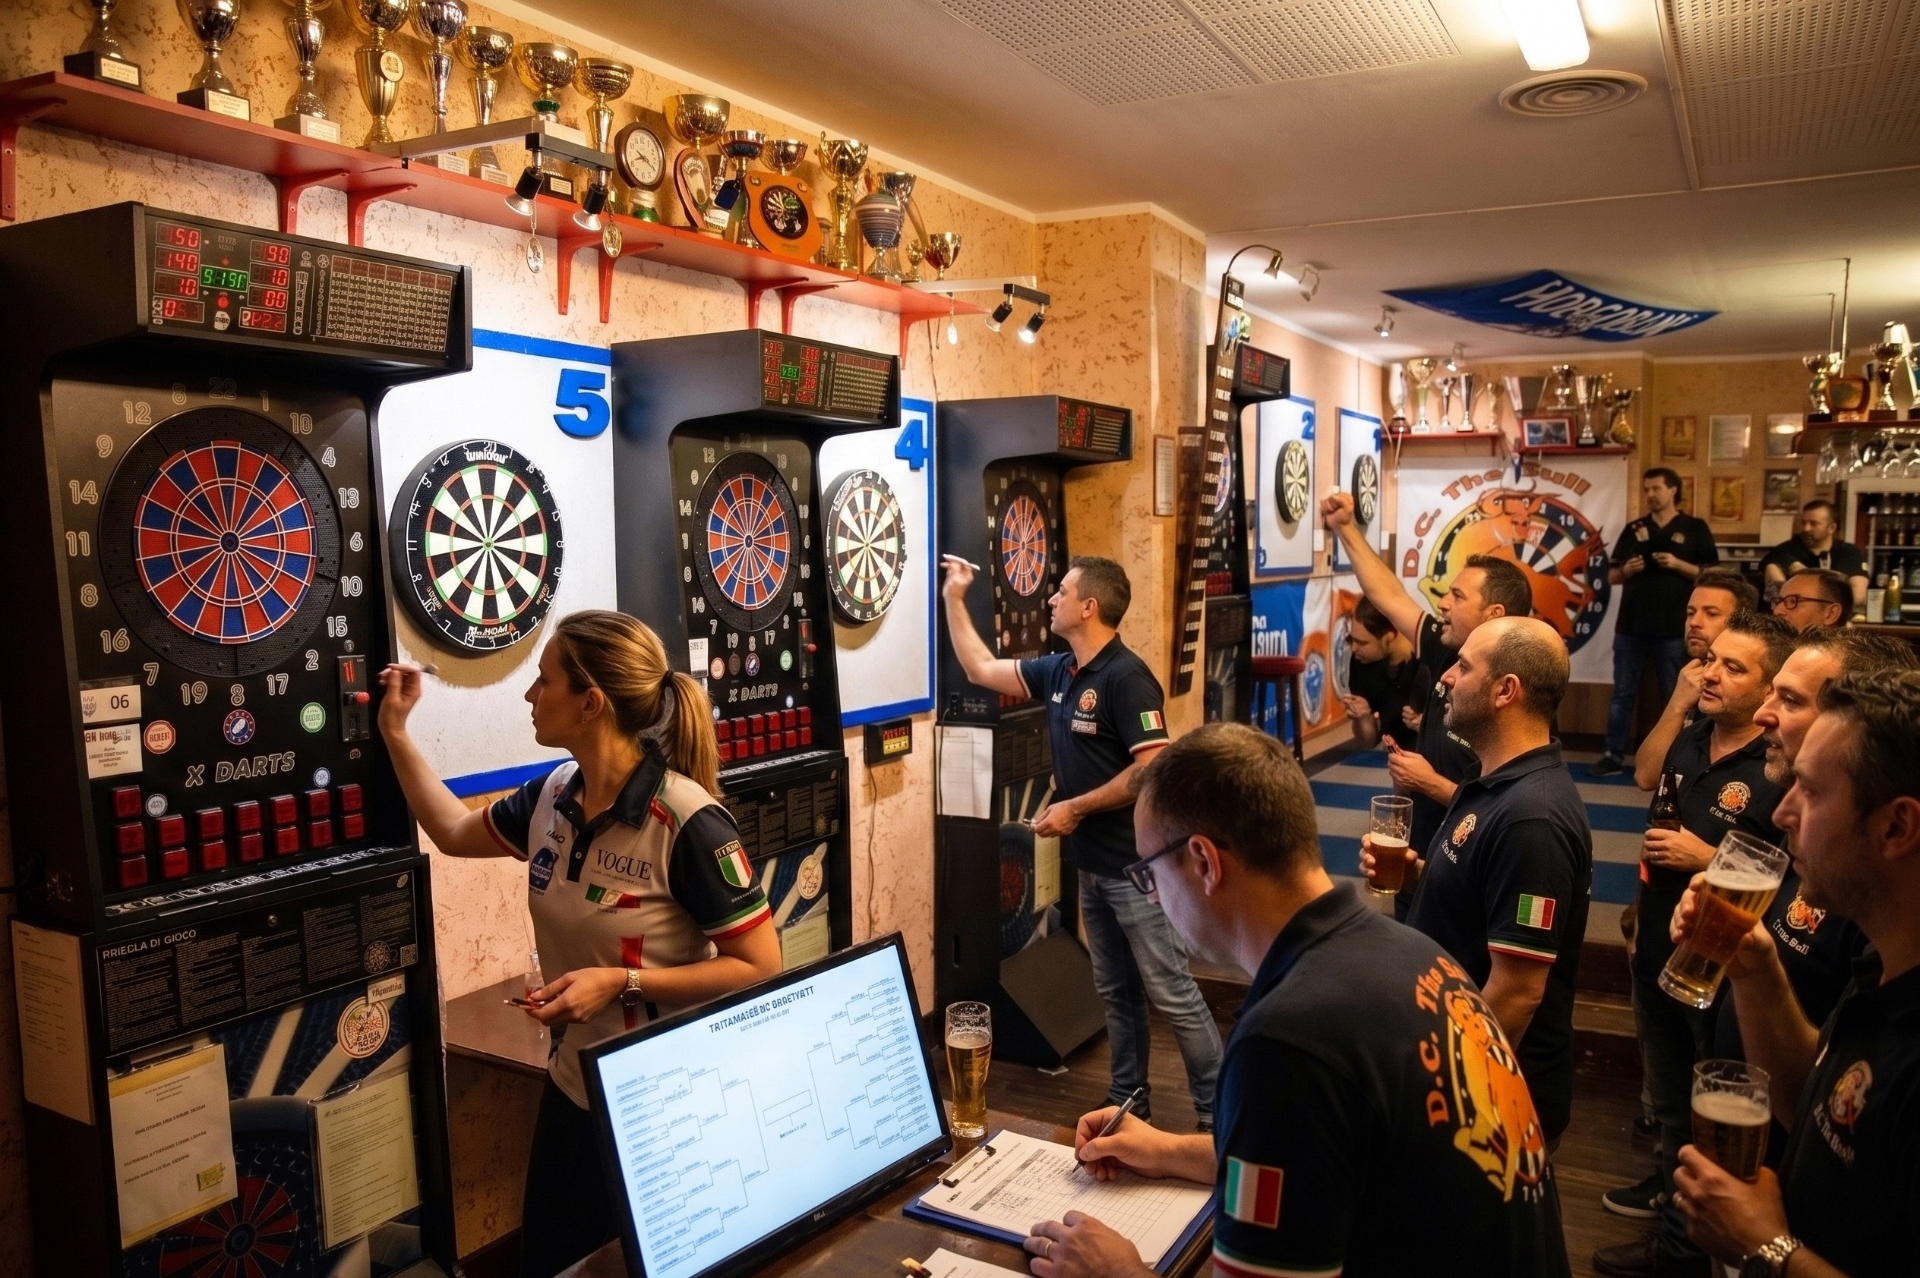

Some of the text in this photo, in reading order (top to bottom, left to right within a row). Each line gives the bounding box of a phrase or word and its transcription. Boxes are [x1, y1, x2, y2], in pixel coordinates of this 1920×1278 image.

[122, 401, 151, 425] 12
[260, 390, 269, 412] 1
[554, 368, 611, 439] 5
[290, 412, 313, 435] 10
[1301, 410, 1314, 440] 2
[96, 434, 114, 458] 9
[322, 446, 336, 468] 4
[894, 419, 929, 472] 4
[69, 480, 98, 504] 14
[66, 531, 91, 556] 11
[350, 532, 364, 552] 6
[1402, 508, 1442, 578] D.C.
[80, 583, 99, 608] 8
[341, 576, 363, 598] 10
[326, 616, 348, 638] 15
[100, 628, 130, 654] 16
[305, 650, 320, 671] 2
[143, 662, 160, 686] 7
[267, 673, 289, 696] 17
[110, 694, 130, 710] 06
[181, 681, 208, 706] 19
[230, 683, 246, 706] 8
[728, 688, 738, 702] X
[184, 751, 296, 788] X DARTS
[597, 848, 652, 880] VOGUE
[150, 938, 160, 948] DI
[164, 930, 197, 944] GIOCO
